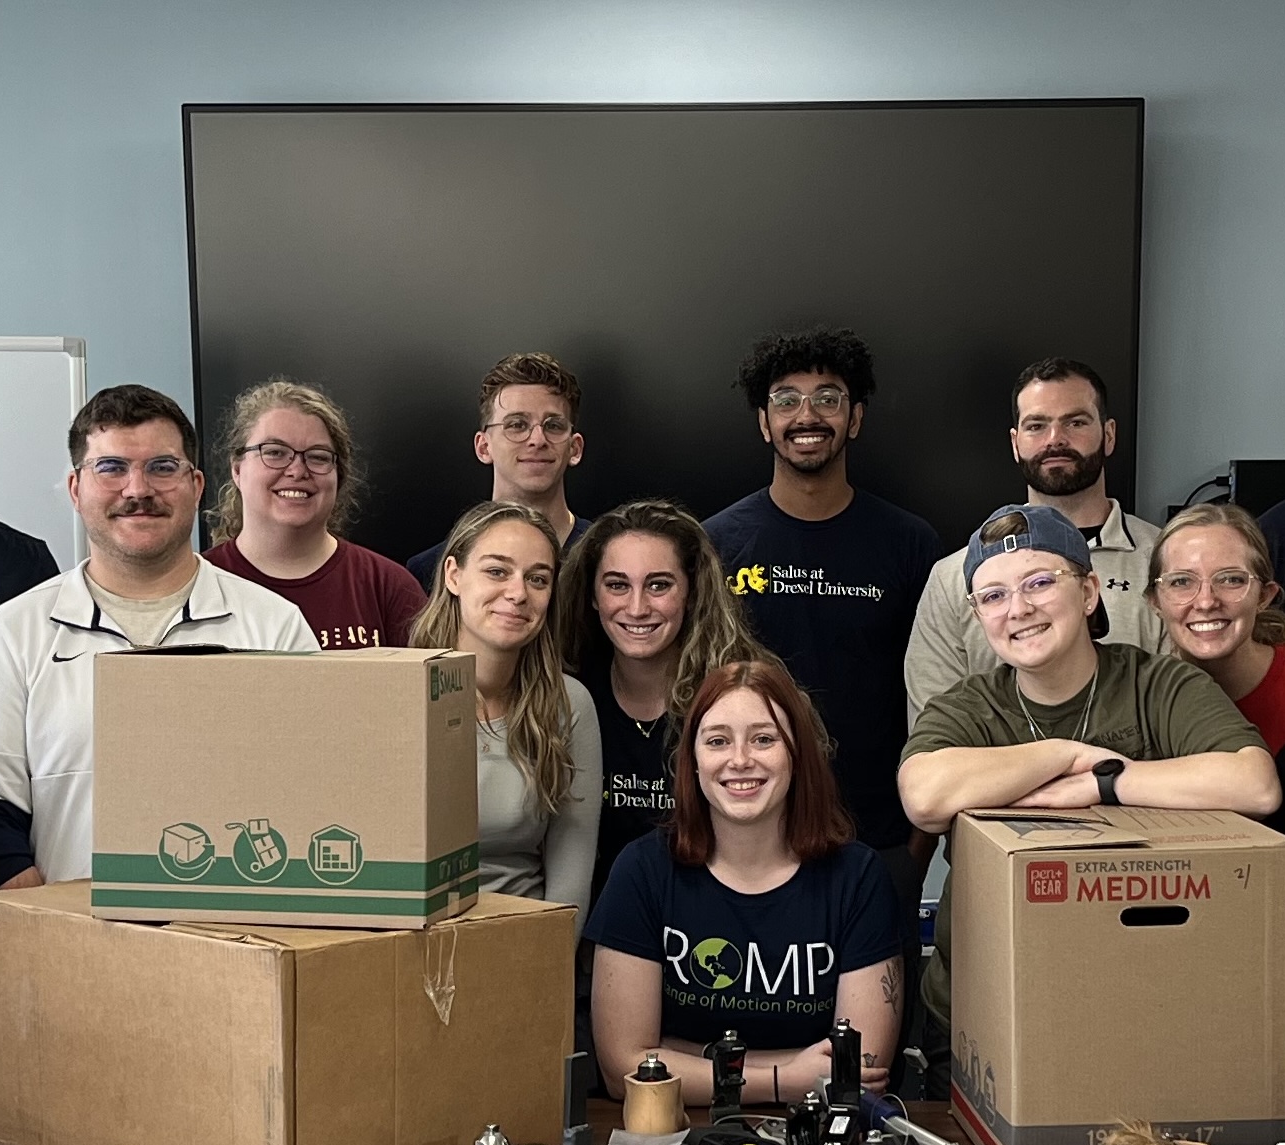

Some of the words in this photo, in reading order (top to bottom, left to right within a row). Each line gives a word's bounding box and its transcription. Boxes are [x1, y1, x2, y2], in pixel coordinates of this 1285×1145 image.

[772, 566, 808, 579] Salus
[810, 567, 825, 580] at
[773, 581, 814, 595] Drexel
[817, 582, 885, 601] University
[613, 774, 649, 790] Salus
[651, 778, 665, 791] at
[613, 793, 656, 809] Drexel
[1075, 861, 1117, 873] EXTRA
[1121, 860, 1192, 872] STRENGTH
[1034, 880, 1062, 895] GEAR
[1076, 875, 1211, 902] MEDIUM
[665, 983, 697, 1006] ange
[699, 993, 717, 1010] of
[720, 996, 781, 1012] Motion
